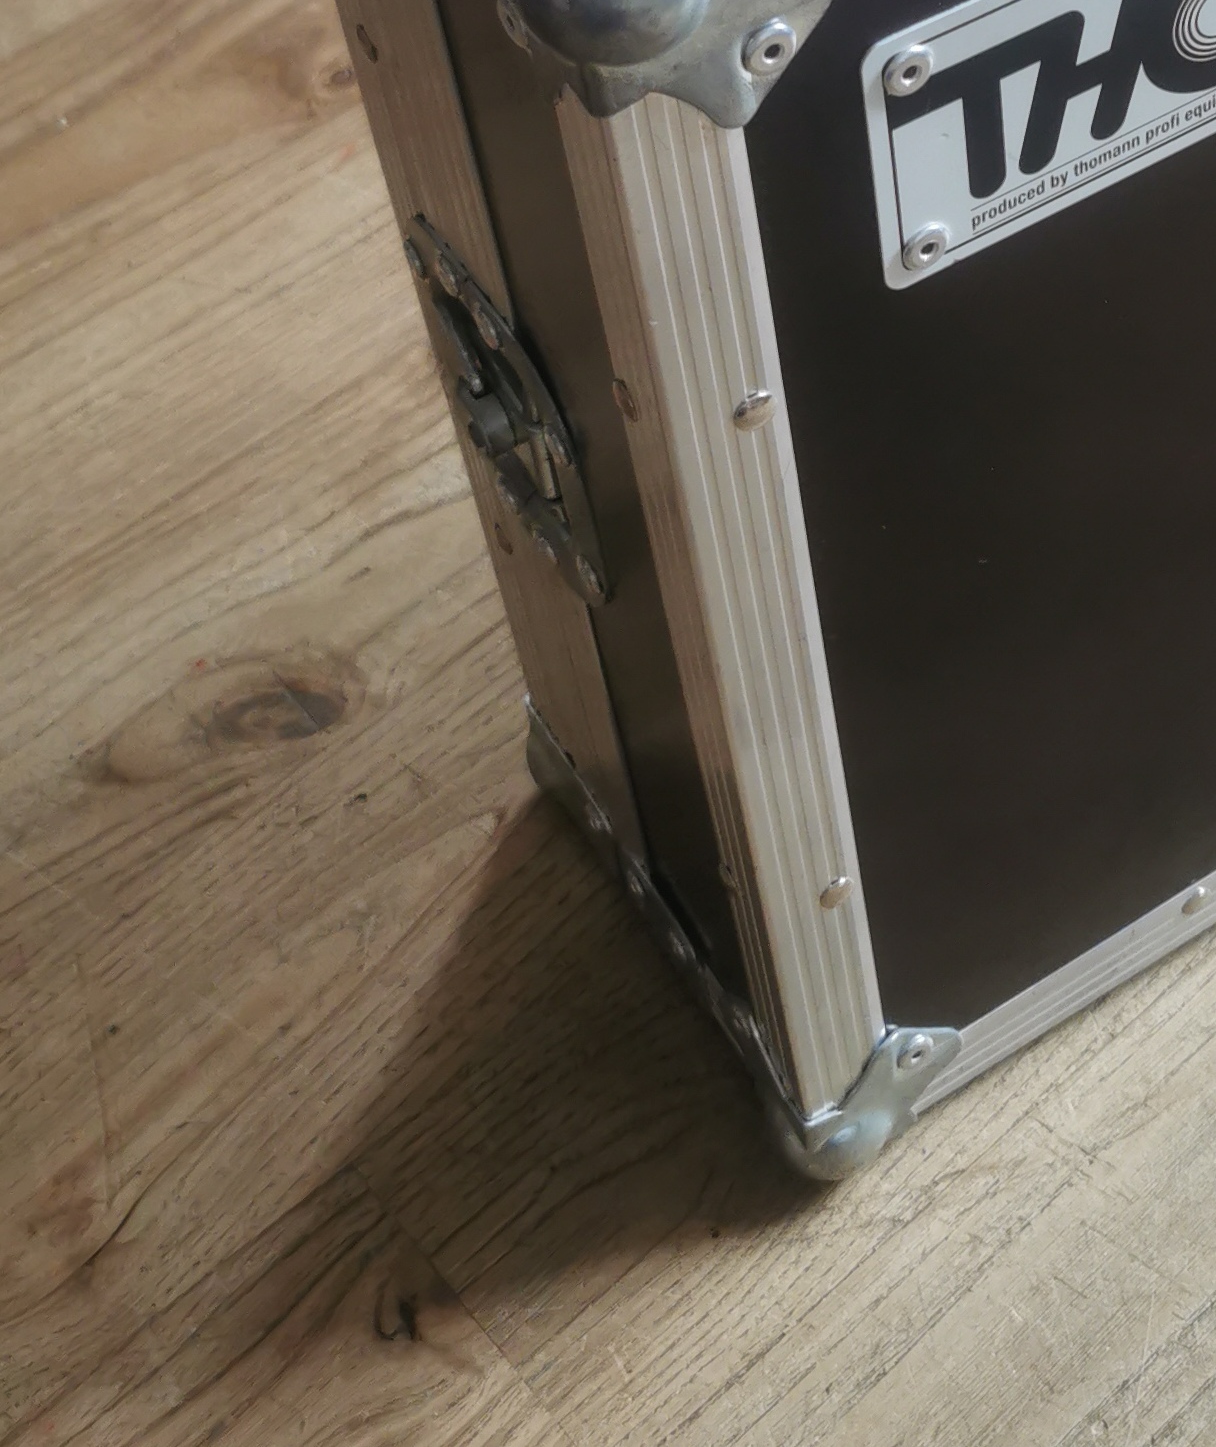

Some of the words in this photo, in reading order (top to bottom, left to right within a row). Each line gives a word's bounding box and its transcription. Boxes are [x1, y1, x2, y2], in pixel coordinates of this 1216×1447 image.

[971, 180, 1046, 230] produced
[1050, 170, 1069, 189] by
[1073, 135, 1141, 177] thomann
[1145, 111, 1180, 144] profi
